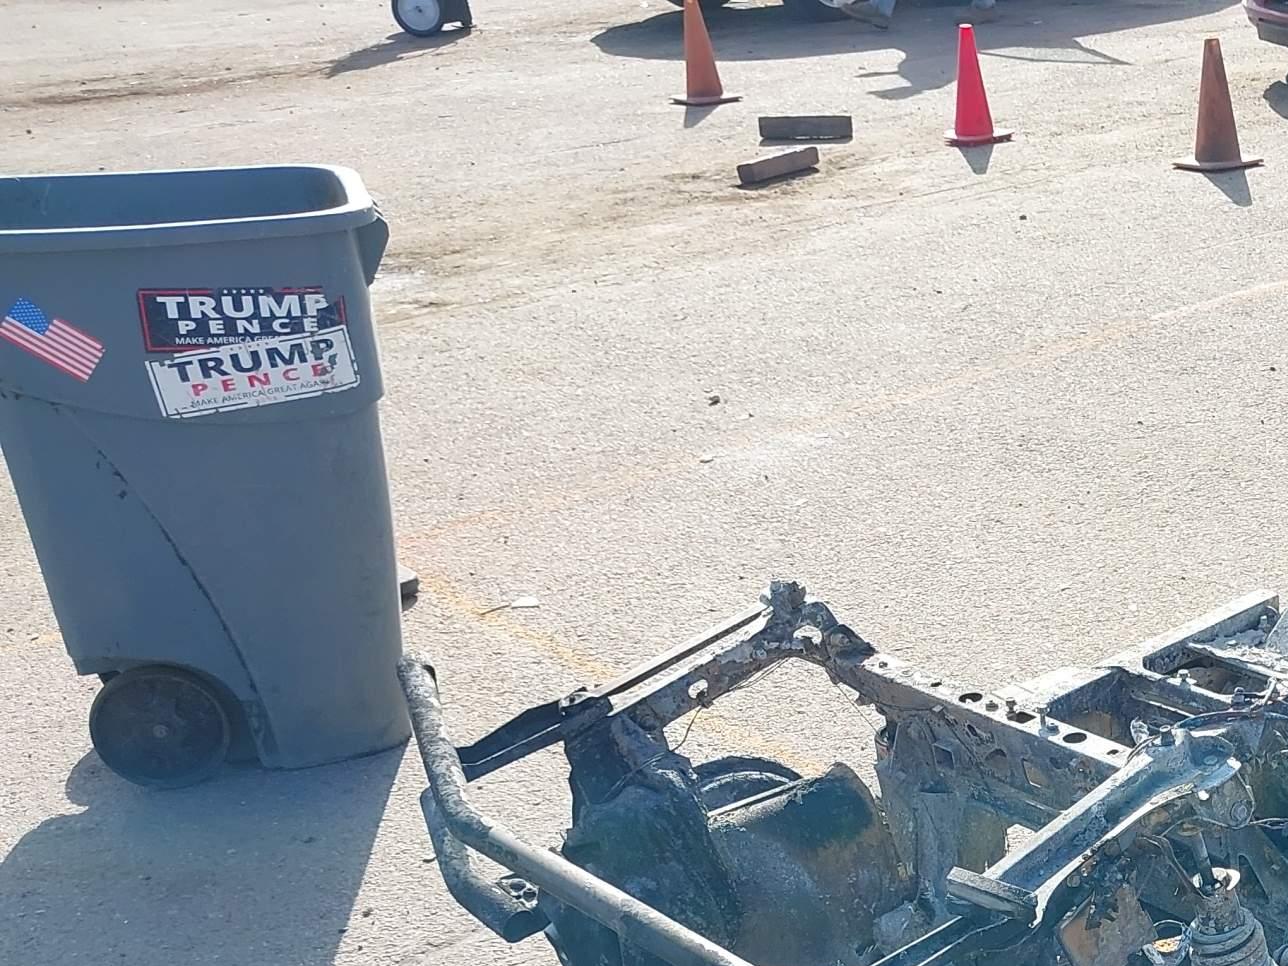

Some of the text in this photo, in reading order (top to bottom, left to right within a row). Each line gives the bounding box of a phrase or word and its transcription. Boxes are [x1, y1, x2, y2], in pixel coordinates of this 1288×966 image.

[156, 294, 329, 319] TRUMP
[178, 317, 320, 335] PENCE
[175, 337, 205, 345] MAKE
[206, 335, 252, 344] AMERICA
[167, 338, 335, 383] TRUMP
[191, 362, 325, 397] PENCE
[222, 388, 266, 403] AMERICA
[267, 383, 298, 394] GREAT
